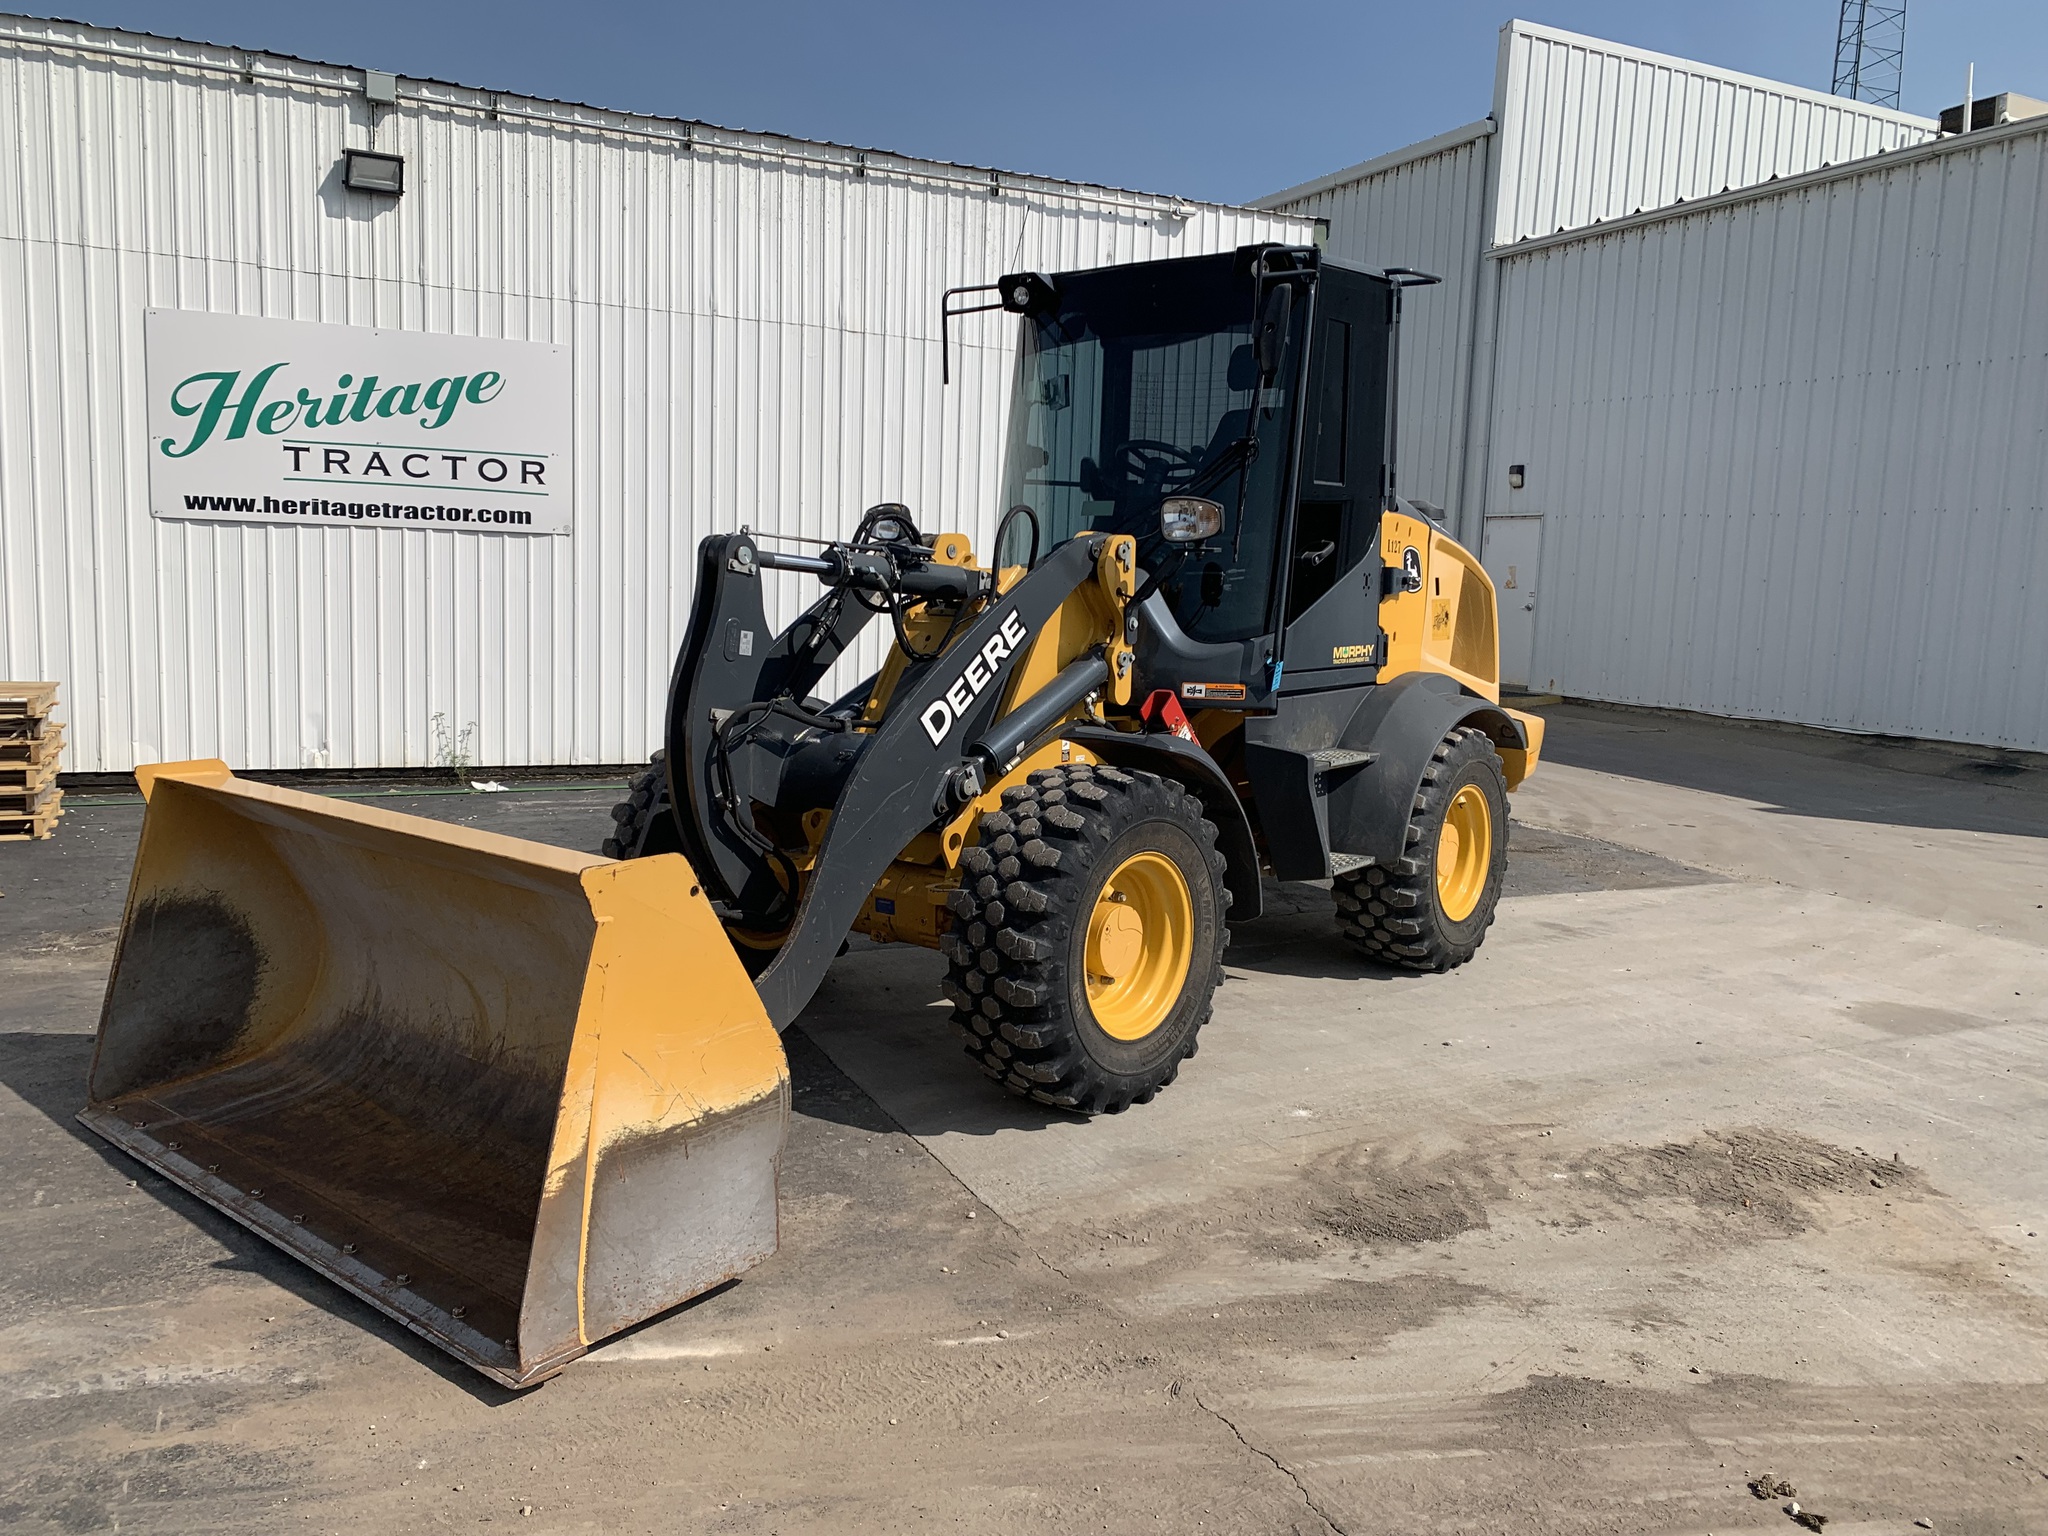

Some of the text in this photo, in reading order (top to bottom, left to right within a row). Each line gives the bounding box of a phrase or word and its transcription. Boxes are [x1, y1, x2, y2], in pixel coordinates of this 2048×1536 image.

[161, 362, 506, 458] Heritage
[283, 445, 546, 485] TRACTOR
[184, 495, 531, 525] www.heritagetractor.com
[1333, 644, 1375, 659] MURPHY
[920, 609, 1027, 747] DEERE
